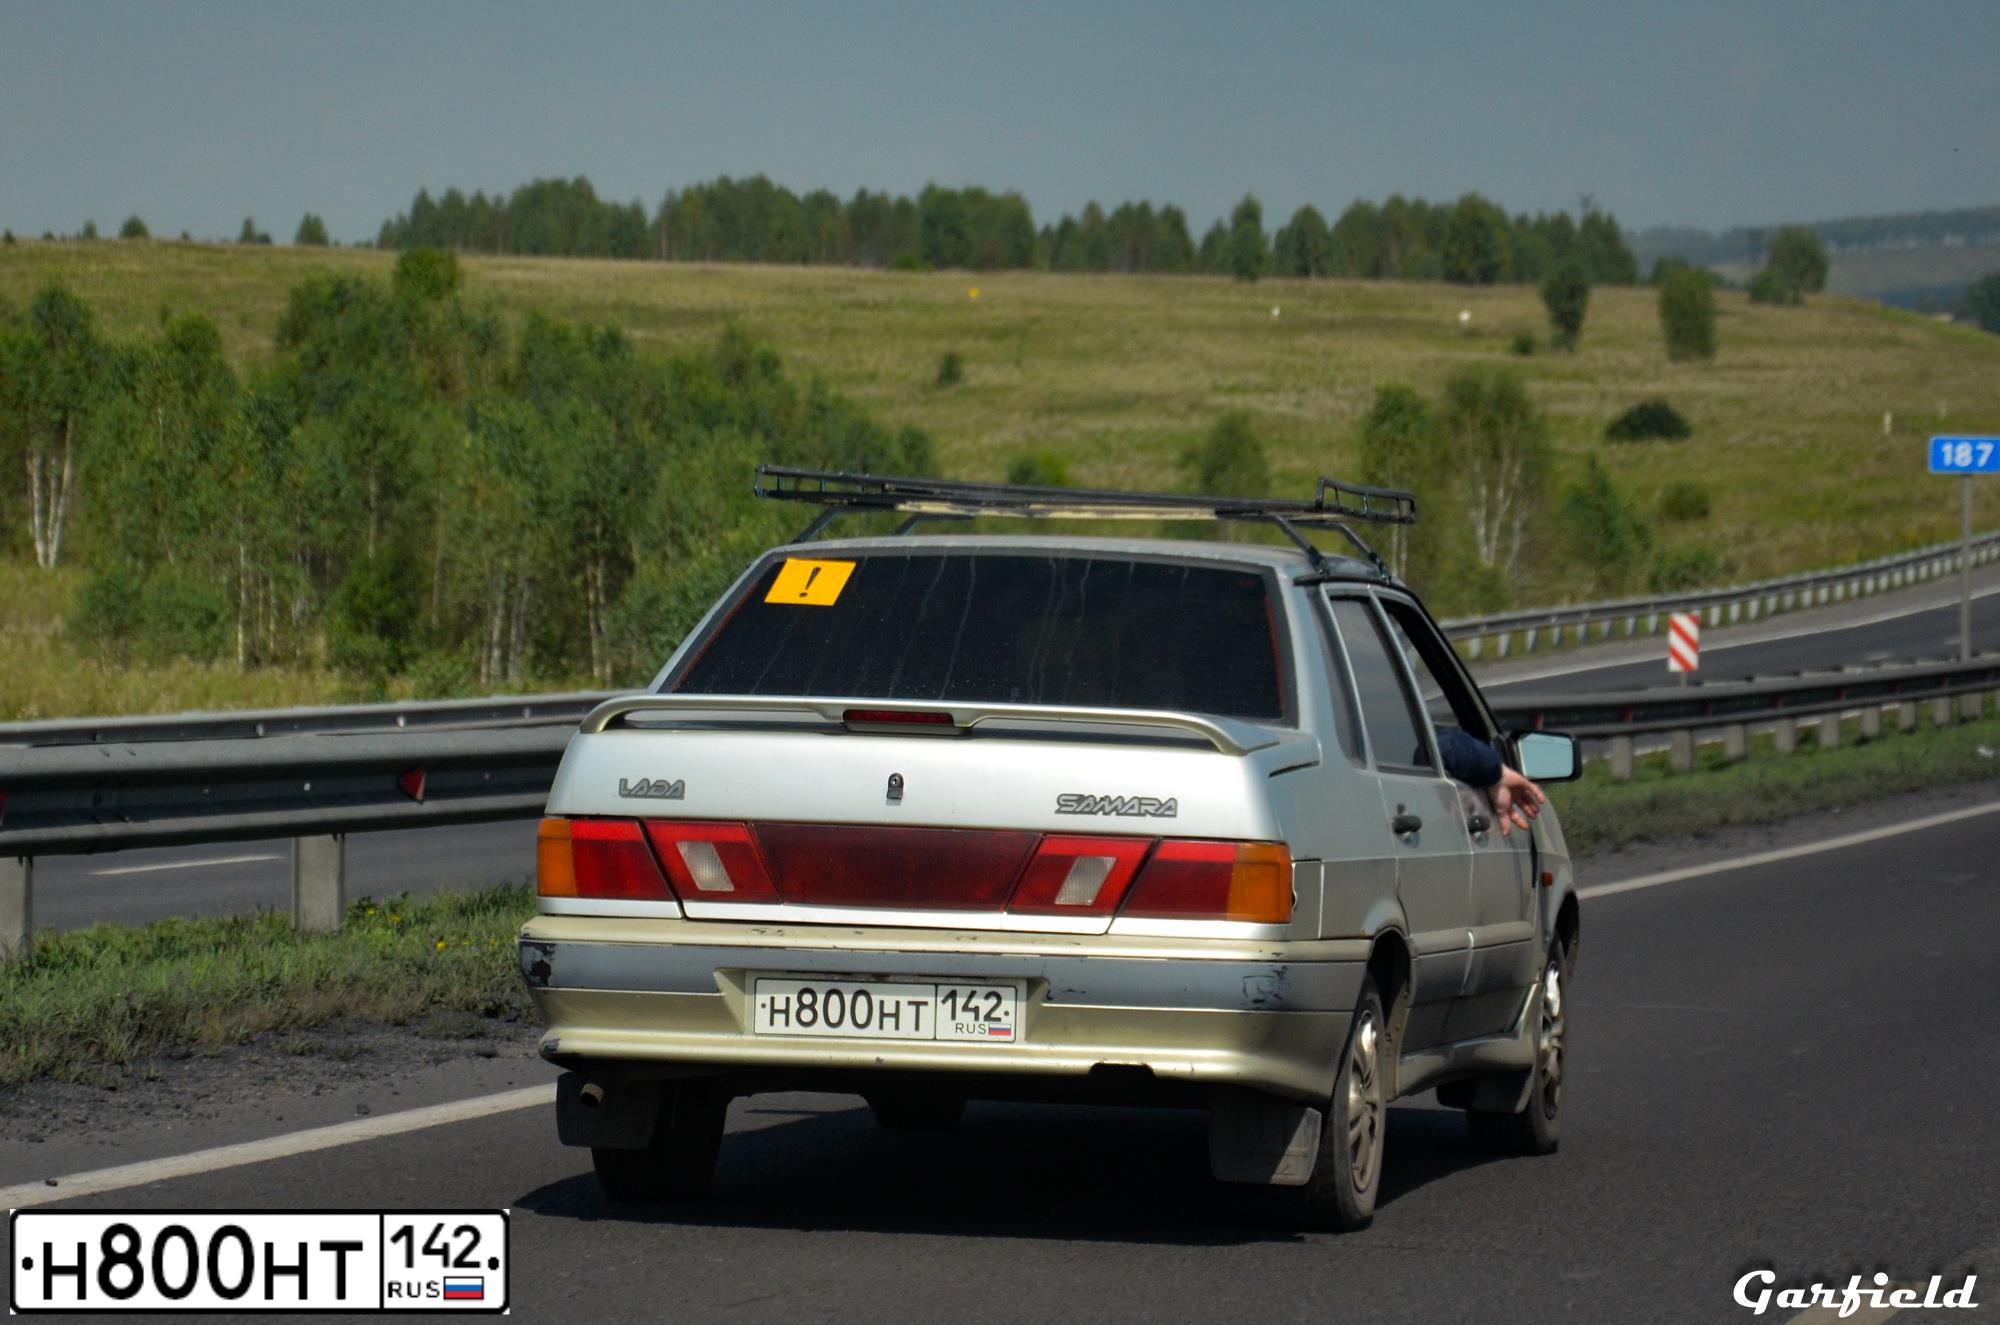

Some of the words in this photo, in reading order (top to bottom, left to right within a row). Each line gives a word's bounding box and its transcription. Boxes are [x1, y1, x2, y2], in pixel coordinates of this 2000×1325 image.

[1941, 442, 1994, 467] 187
[619, 778, 685, 800] LADA
[1055, 793, 1178, 818] SAMARA
[941, 989, 1002, 1022] 142
[955, 1022, 987, 1034] RUS
